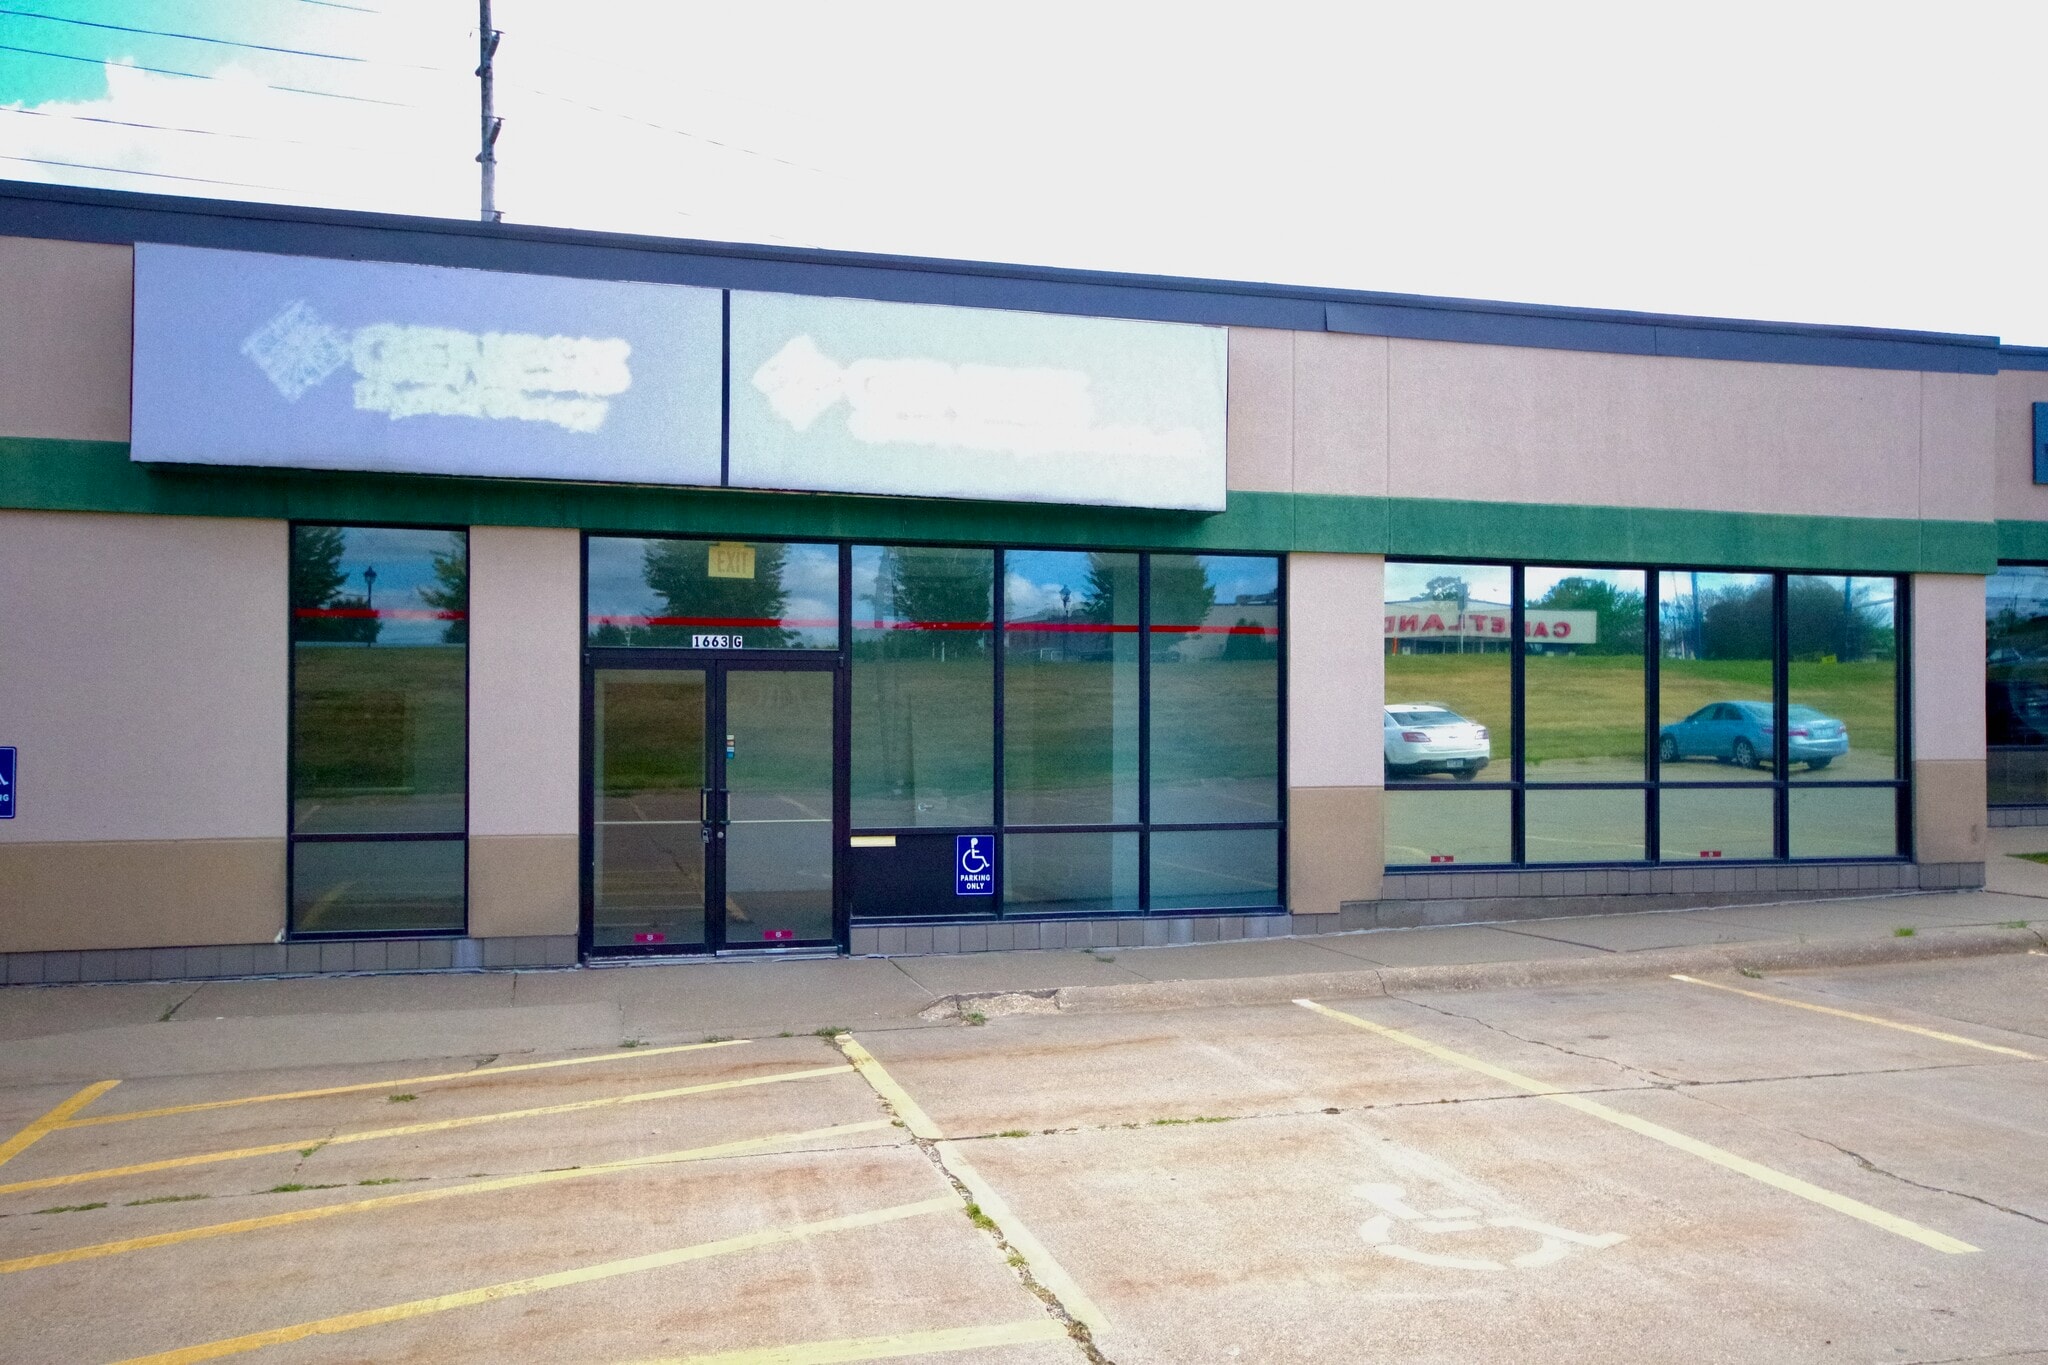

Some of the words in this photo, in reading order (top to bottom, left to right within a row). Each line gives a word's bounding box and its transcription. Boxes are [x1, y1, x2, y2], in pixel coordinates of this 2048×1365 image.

[717, 550, 748, 573] EXIT
[694, 636, 728, 647] 1663
[734, 636, 742, 647] G
